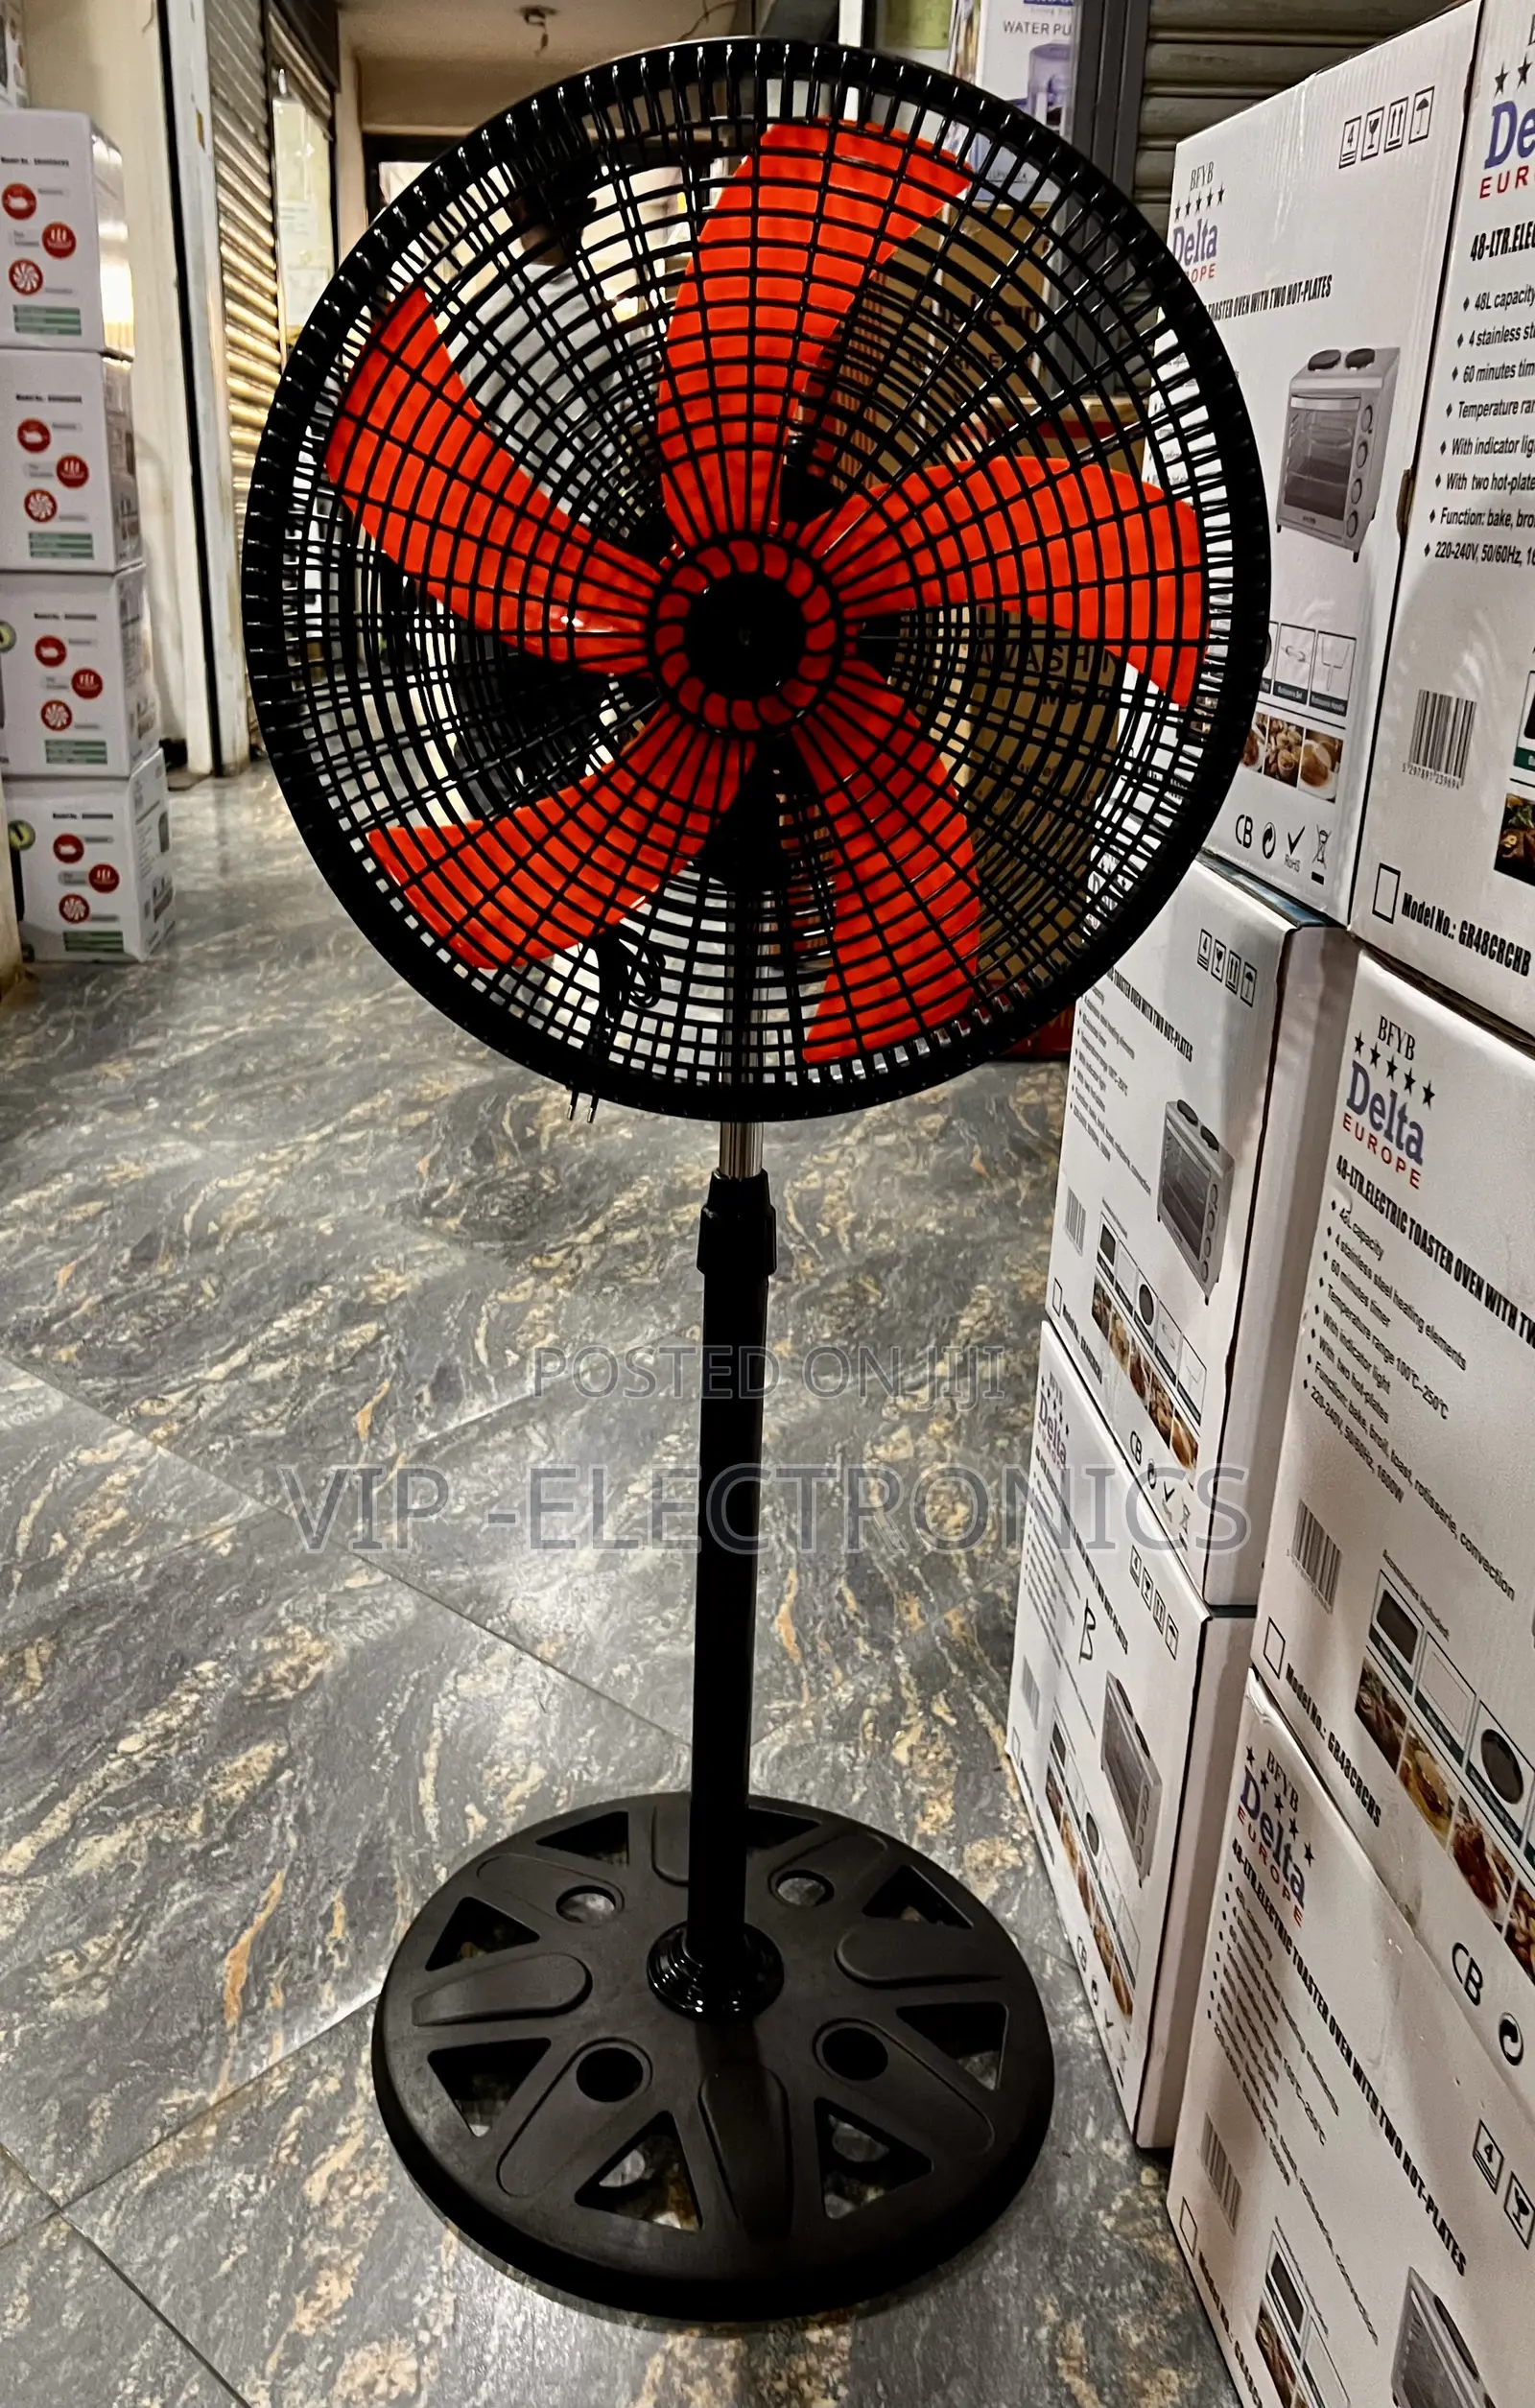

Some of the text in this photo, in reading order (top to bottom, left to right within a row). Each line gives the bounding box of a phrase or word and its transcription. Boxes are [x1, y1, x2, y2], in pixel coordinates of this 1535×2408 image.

[1004, 20, 1049, 35] WATER
[1479, 165, 1535, 199] EUR
[1172, 218, 1217, 267] Delta
[1185, 263, 1216, 284] OPE
[1286, 274, 1332, 306] HOT-PLATES
[1475, 284, 1535, 311] 48L capacity
[1468, 329, 1476, 346] 4
[1476, 325, 1522, 347] stainless
[1463, 365, 1476, 384] 60
[1476, 363, 1516, 382] minutes
[1458, 399, 1519, 422] Temperature
[1452, 437, 1473, 456] With
[1474, 436, 1520, 455] indicator
[1446, 472, 1468, 491] With
[1471, 474, 1490, 490] two
[1440, 507, 1485, 527] Function:
[1487, 508, 1513, 531] bake,
[1434, 541, 1478, 563] 220-240V,
[1480, 543, 1523, 568] 50/60Hz,
[1401, 892, 1532, 977] Model No.: GR48CRCHB
[1378, 1013, 1415, 1062] BFYB
[1345, 1059, 1425, 1167] Delta
[1343, 1112, 1422, 1190] EUROPE
[1335, 1154, 1407, 1235] 48-LTR.ELECTRIC
[1407, 1216, 1454, 1276] TOASTER
[1453, 1257, 1485, 1302] OVEN
[1484, 1282, 1518, 1332] WITH
[1353, 1222, 1383, 1262] capacity
[1331, 1259, 1391, 1328] 60 minutes timer
[1334, 1234, 1467, 1372] 4 stainless steel heating elements
[1328, 1283, 1371, 1340] Temperature
[1372, 1334, 1395, 1365] range
[1323, 1310, 1391, 1395] With indicator light
[1319, 1334, 1389, 1425] With two hot-plates
[1390, 1449, 1413, 1487] toast,
[1414, 1478, 1457, 1541] rotisserie,
[1459, 1532, 1515, 1601] convection
[1286, 1663, 1311, 1715] Model
[1240, 1764, 1305, 1910] Delta
[1237, 1805, 1303, 1928] EUROPE
[1292, 1945, 1329, 2024] TOASTER
[1329, 2014, 1353, 2068] OVEN
[1353, 2056, 1380, 2117] WITH
[1379, 2105, 1402, 2159] TWO
[1402, 2150, 1467, 2277] HOT-PLATES
